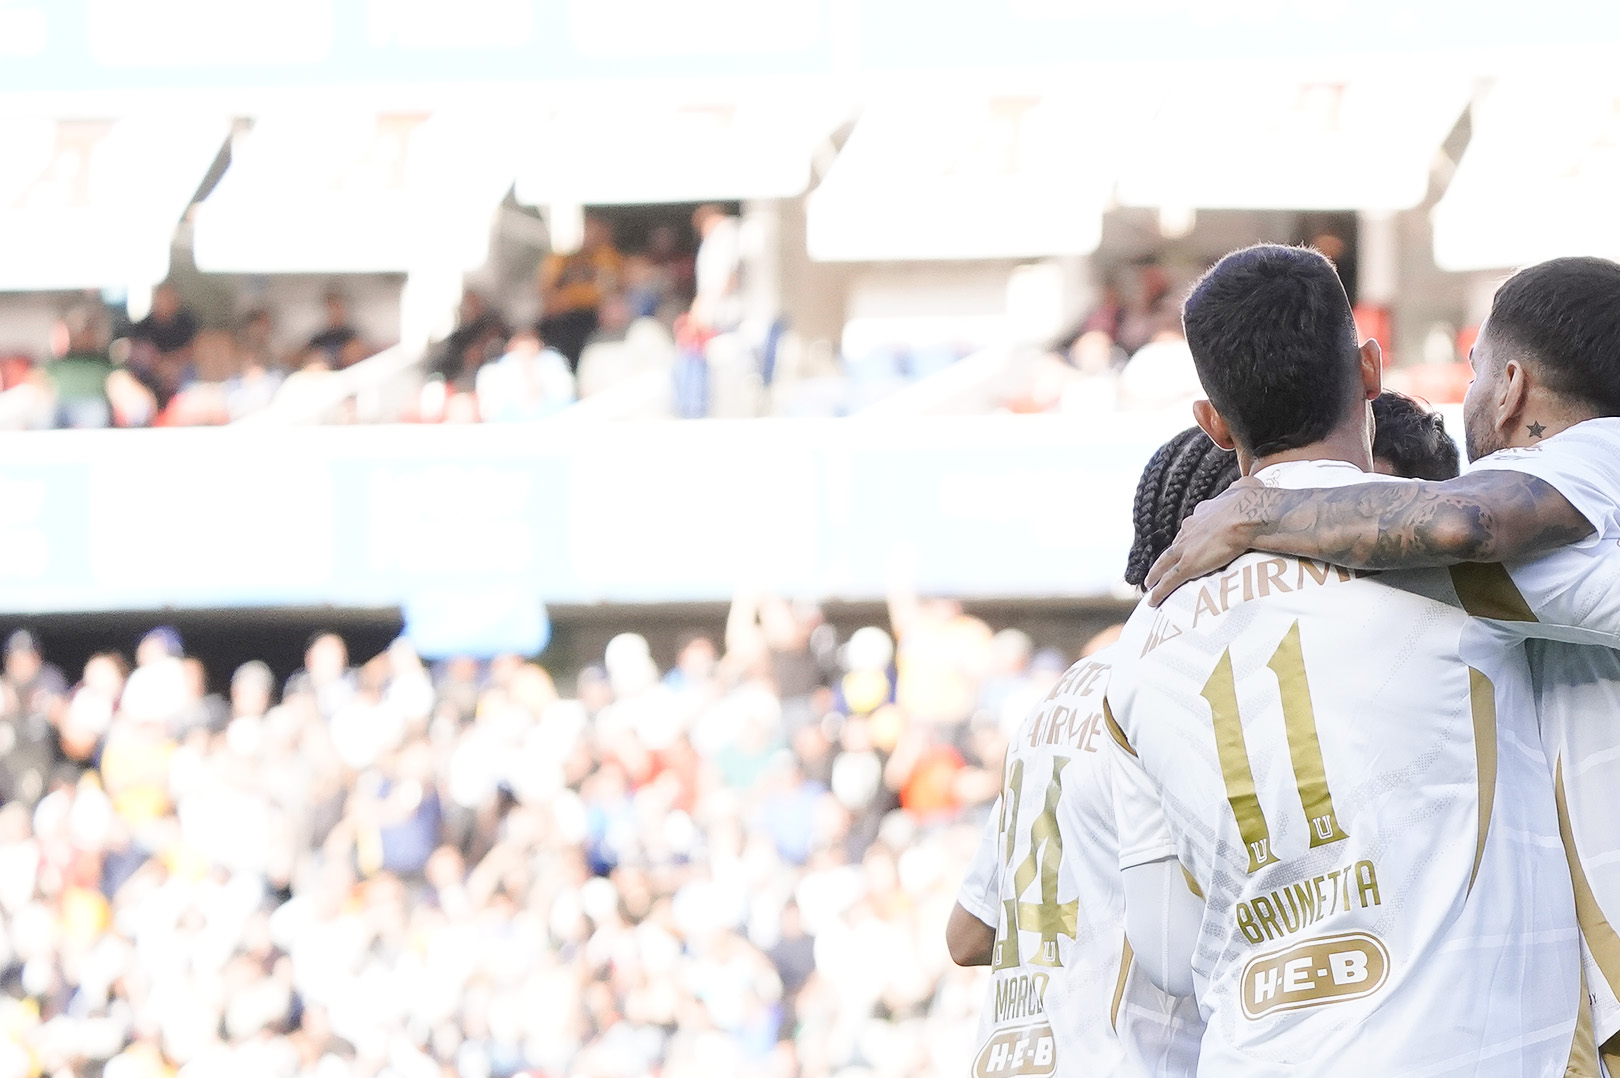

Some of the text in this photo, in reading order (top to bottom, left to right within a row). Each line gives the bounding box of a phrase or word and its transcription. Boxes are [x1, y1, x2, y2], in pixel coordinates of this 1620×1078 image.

[1193, 557, 1383, 629] AFIRM
[1200, 618, 1350, 874] 11
[1236, 860, 1381, 944] BRUNETTA
